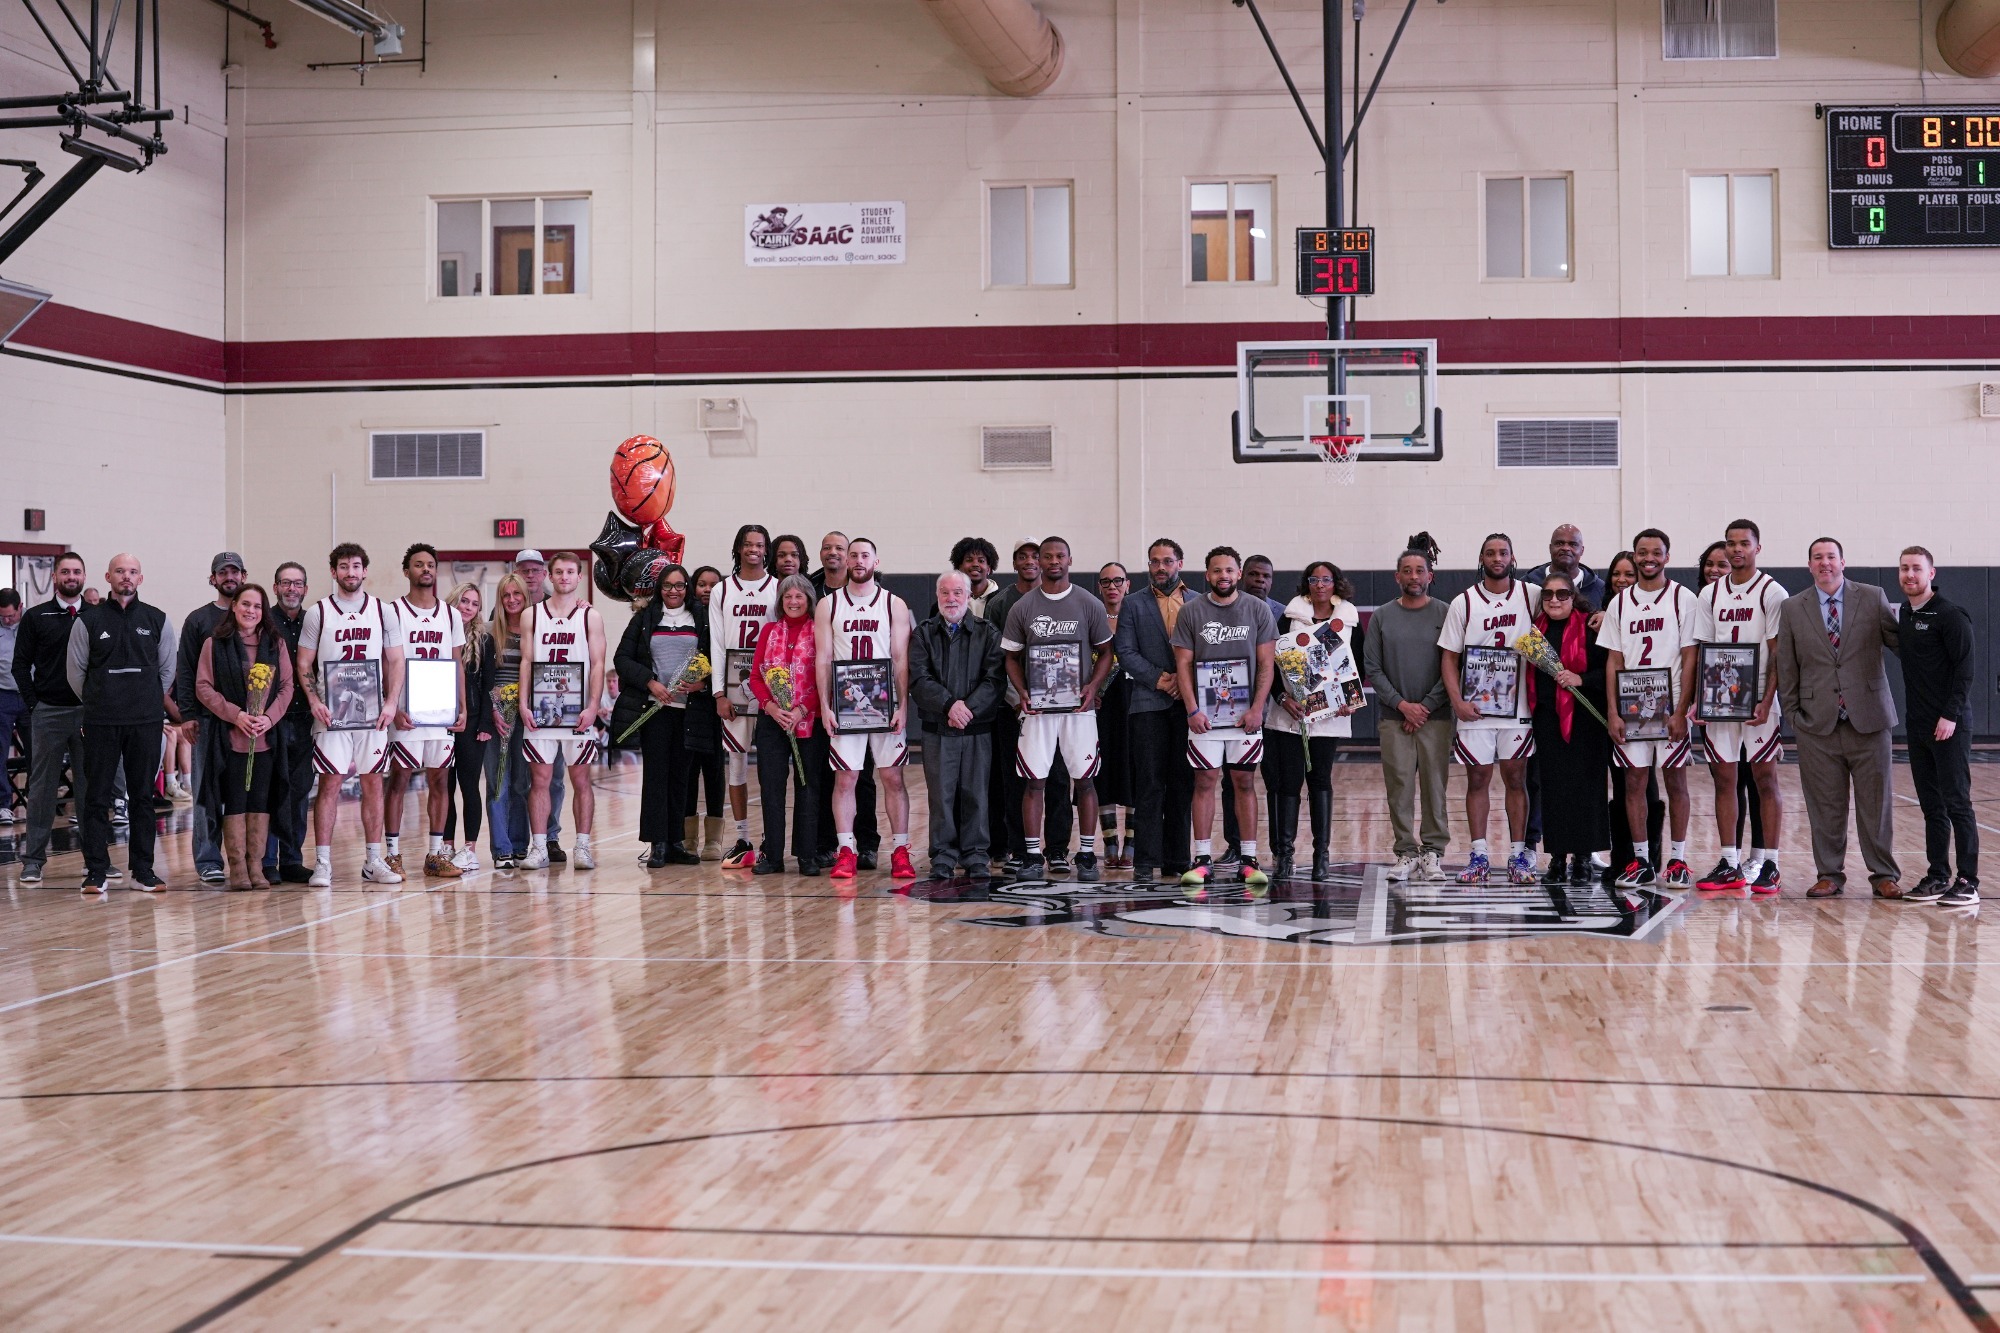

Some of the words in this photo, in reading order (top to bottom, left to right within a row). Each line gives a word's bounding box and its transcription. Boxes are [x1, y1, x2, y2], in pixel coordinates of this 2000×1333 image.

[1839, 116, 1882, 130] HOME
[1867, 137, 1885, 167] 0
[1932, 156, 1953, 164] POSS
[1923, 166, 1962, 177] PERIOD
[1978, 161, 1984, 184] 1
[1857, 174, 1893, 185] BONUS
[1851, 194, 1885, 205] FOULS
[1918, 194, 1958, 205] PLAYER
[861, 207, 895, 216] STUDENT-
[861, 217, 891, 225] ATHLETE
[1869, 207, 1885, 232] 0
[794, 224, 854, 245] SAAC
[861, 225, 895, 234] ADVISORY
[758, 235, 790, 247] CAIRN
[860, 235, 902, 244] COMMITTEE
[1858, 235, 1880, 244] WON
[1314, 257, 1358, 292] 30
[498, 520, 518, 537] EXIT
[733, 604, 767, 616] CAIRN
[1718, 608, 1753, 622] CAIRN
[843, 619, 879, 632] CAIRN
[1047, 621, 1077, 634] CAIRN
[1483, 614, 1517, 631] CAIRN
[1629, 617, 1664, 634] CAIRN
[335, 627, 371, 642] CAIRN
[409, 631, 443, 643] CAIRN
[542, 632, 575, 645] CAIRN
[739, 620, 760, 648] 12
[1218, 626, 1250, 641] CAIRN
[1731, 625, 1740, 643] 1
[851, 636, 874, 660] 10
[1638, 635, 1653, 666] 2
[1212, 666, 1233, 674] CHRIS
[1632, 676, 1655, 686] COREY
